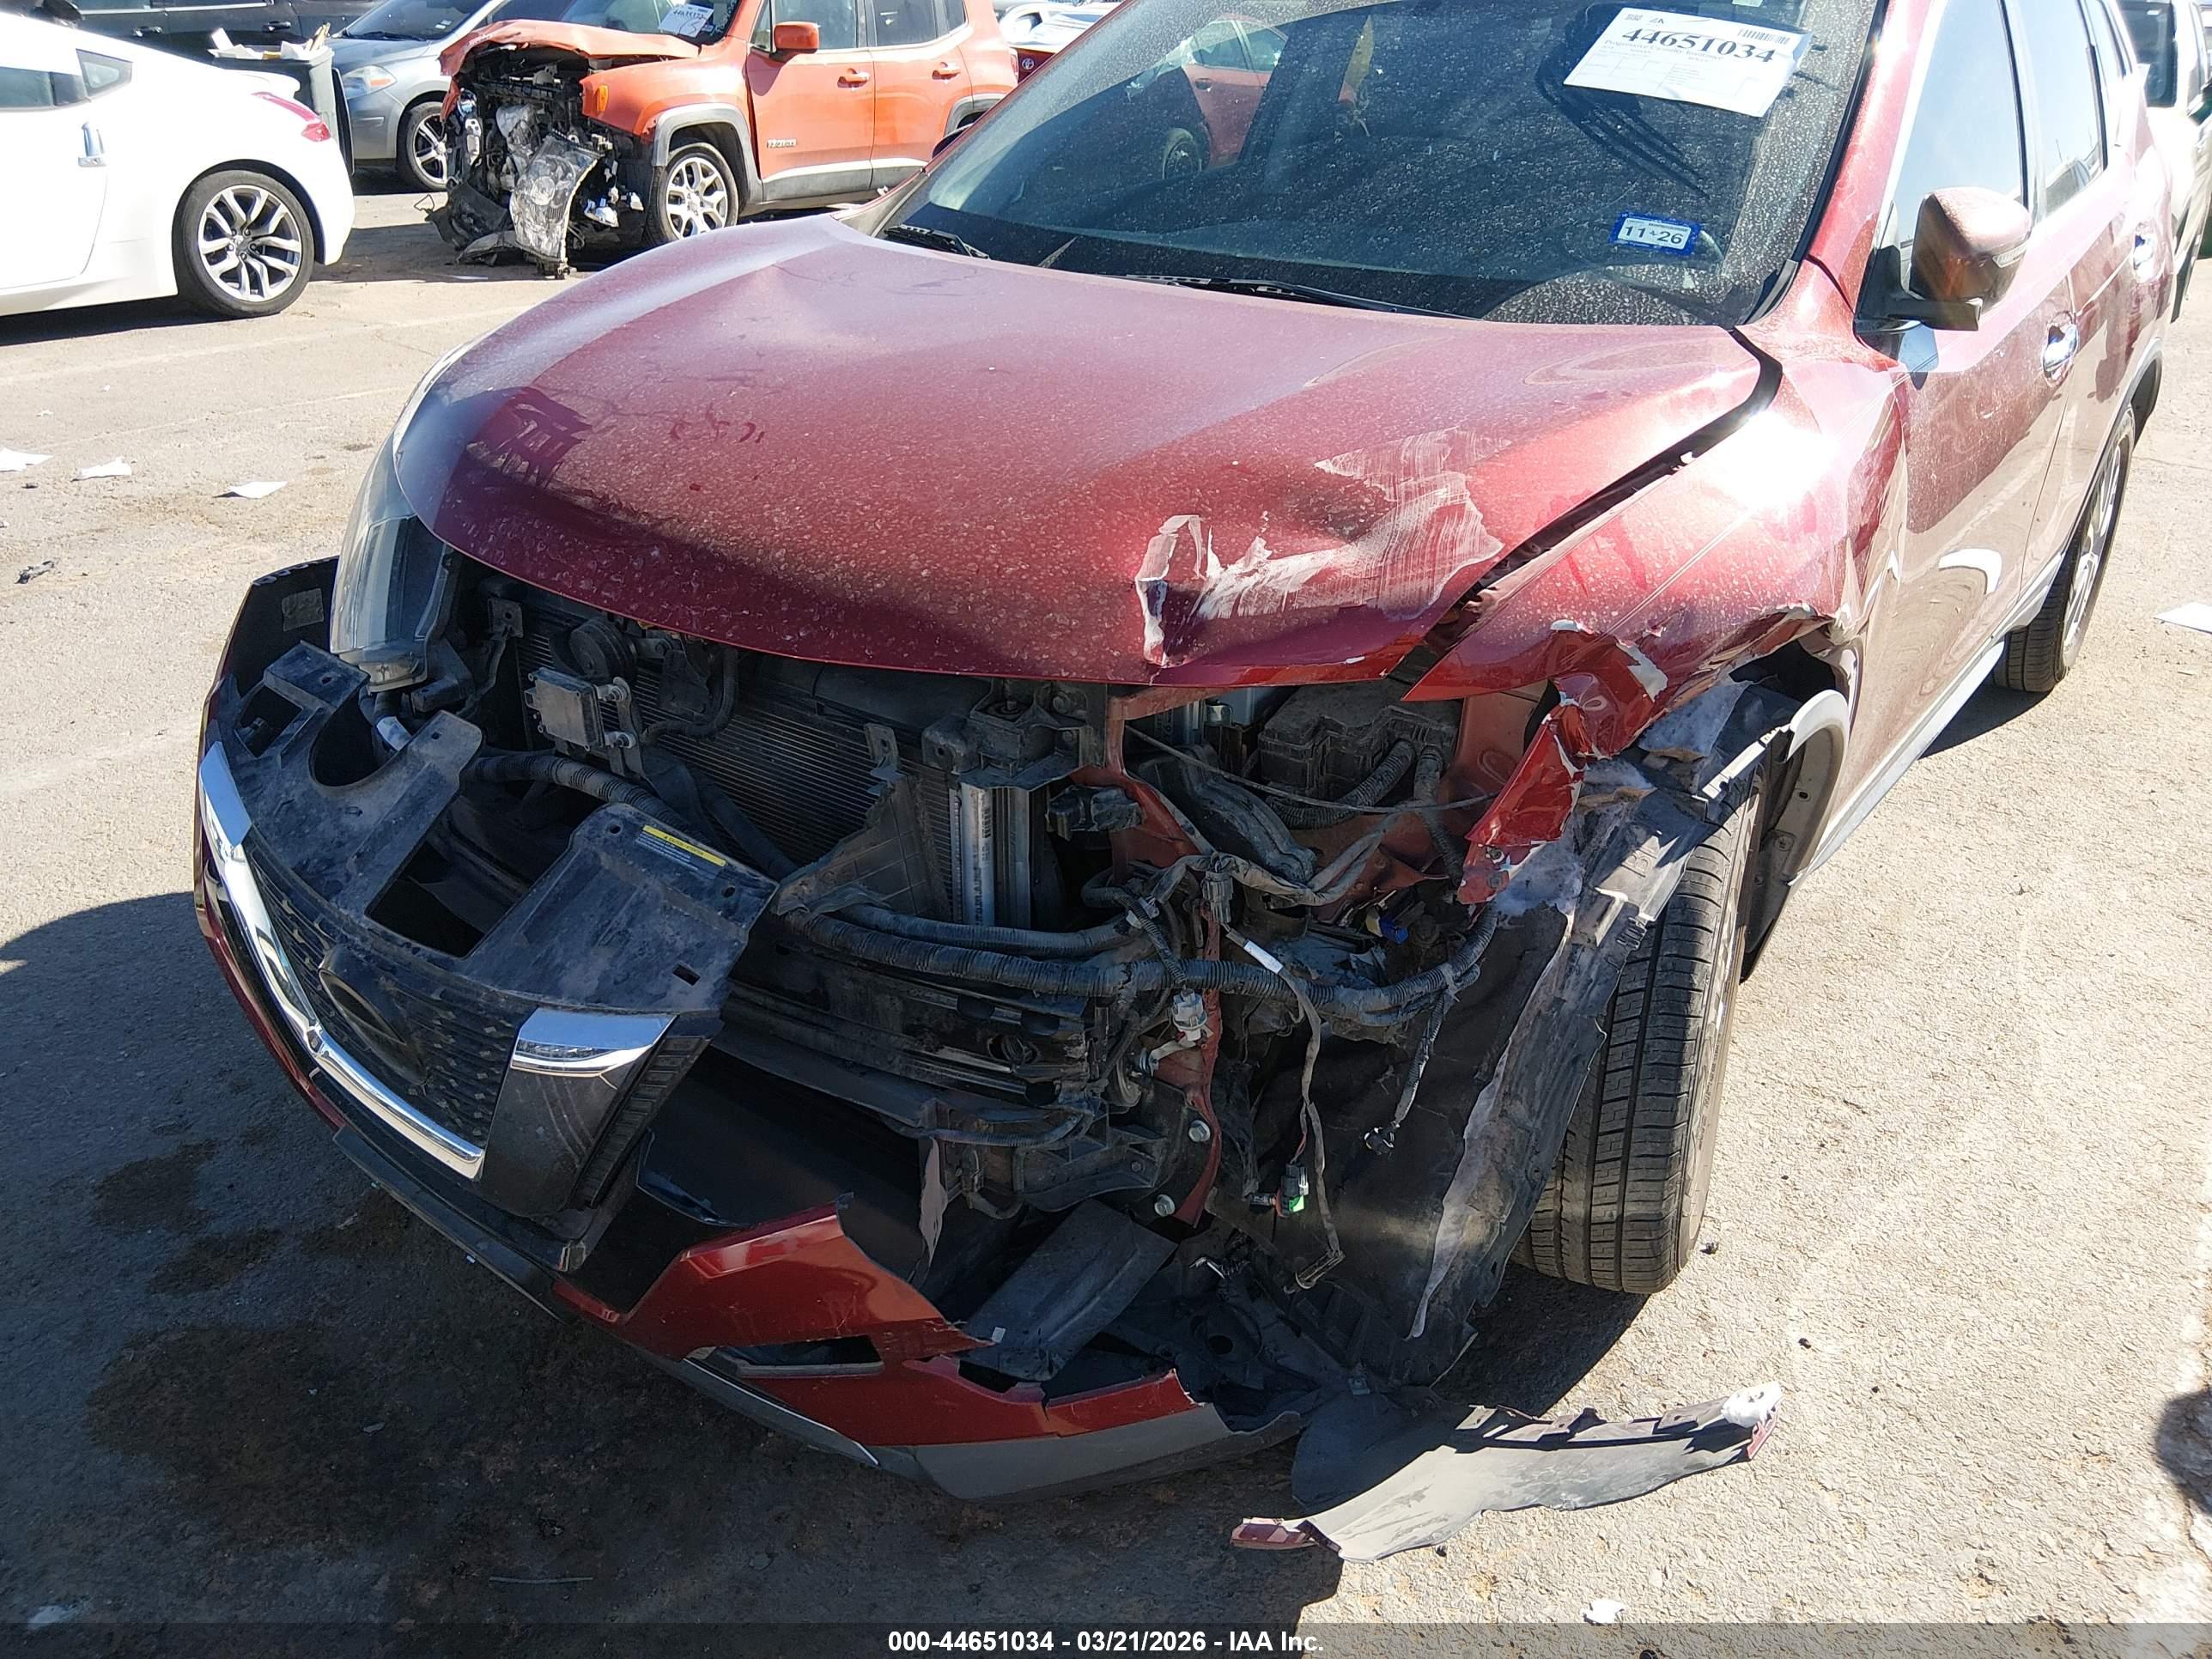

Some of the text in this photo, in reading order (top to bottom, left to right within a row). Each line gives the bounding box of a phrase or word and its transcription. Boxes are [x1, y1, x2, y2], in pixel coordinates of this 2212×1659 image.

[1622, 28, 1775, 63] 44651034
[1626, 226, 1684, 244] 11 26
